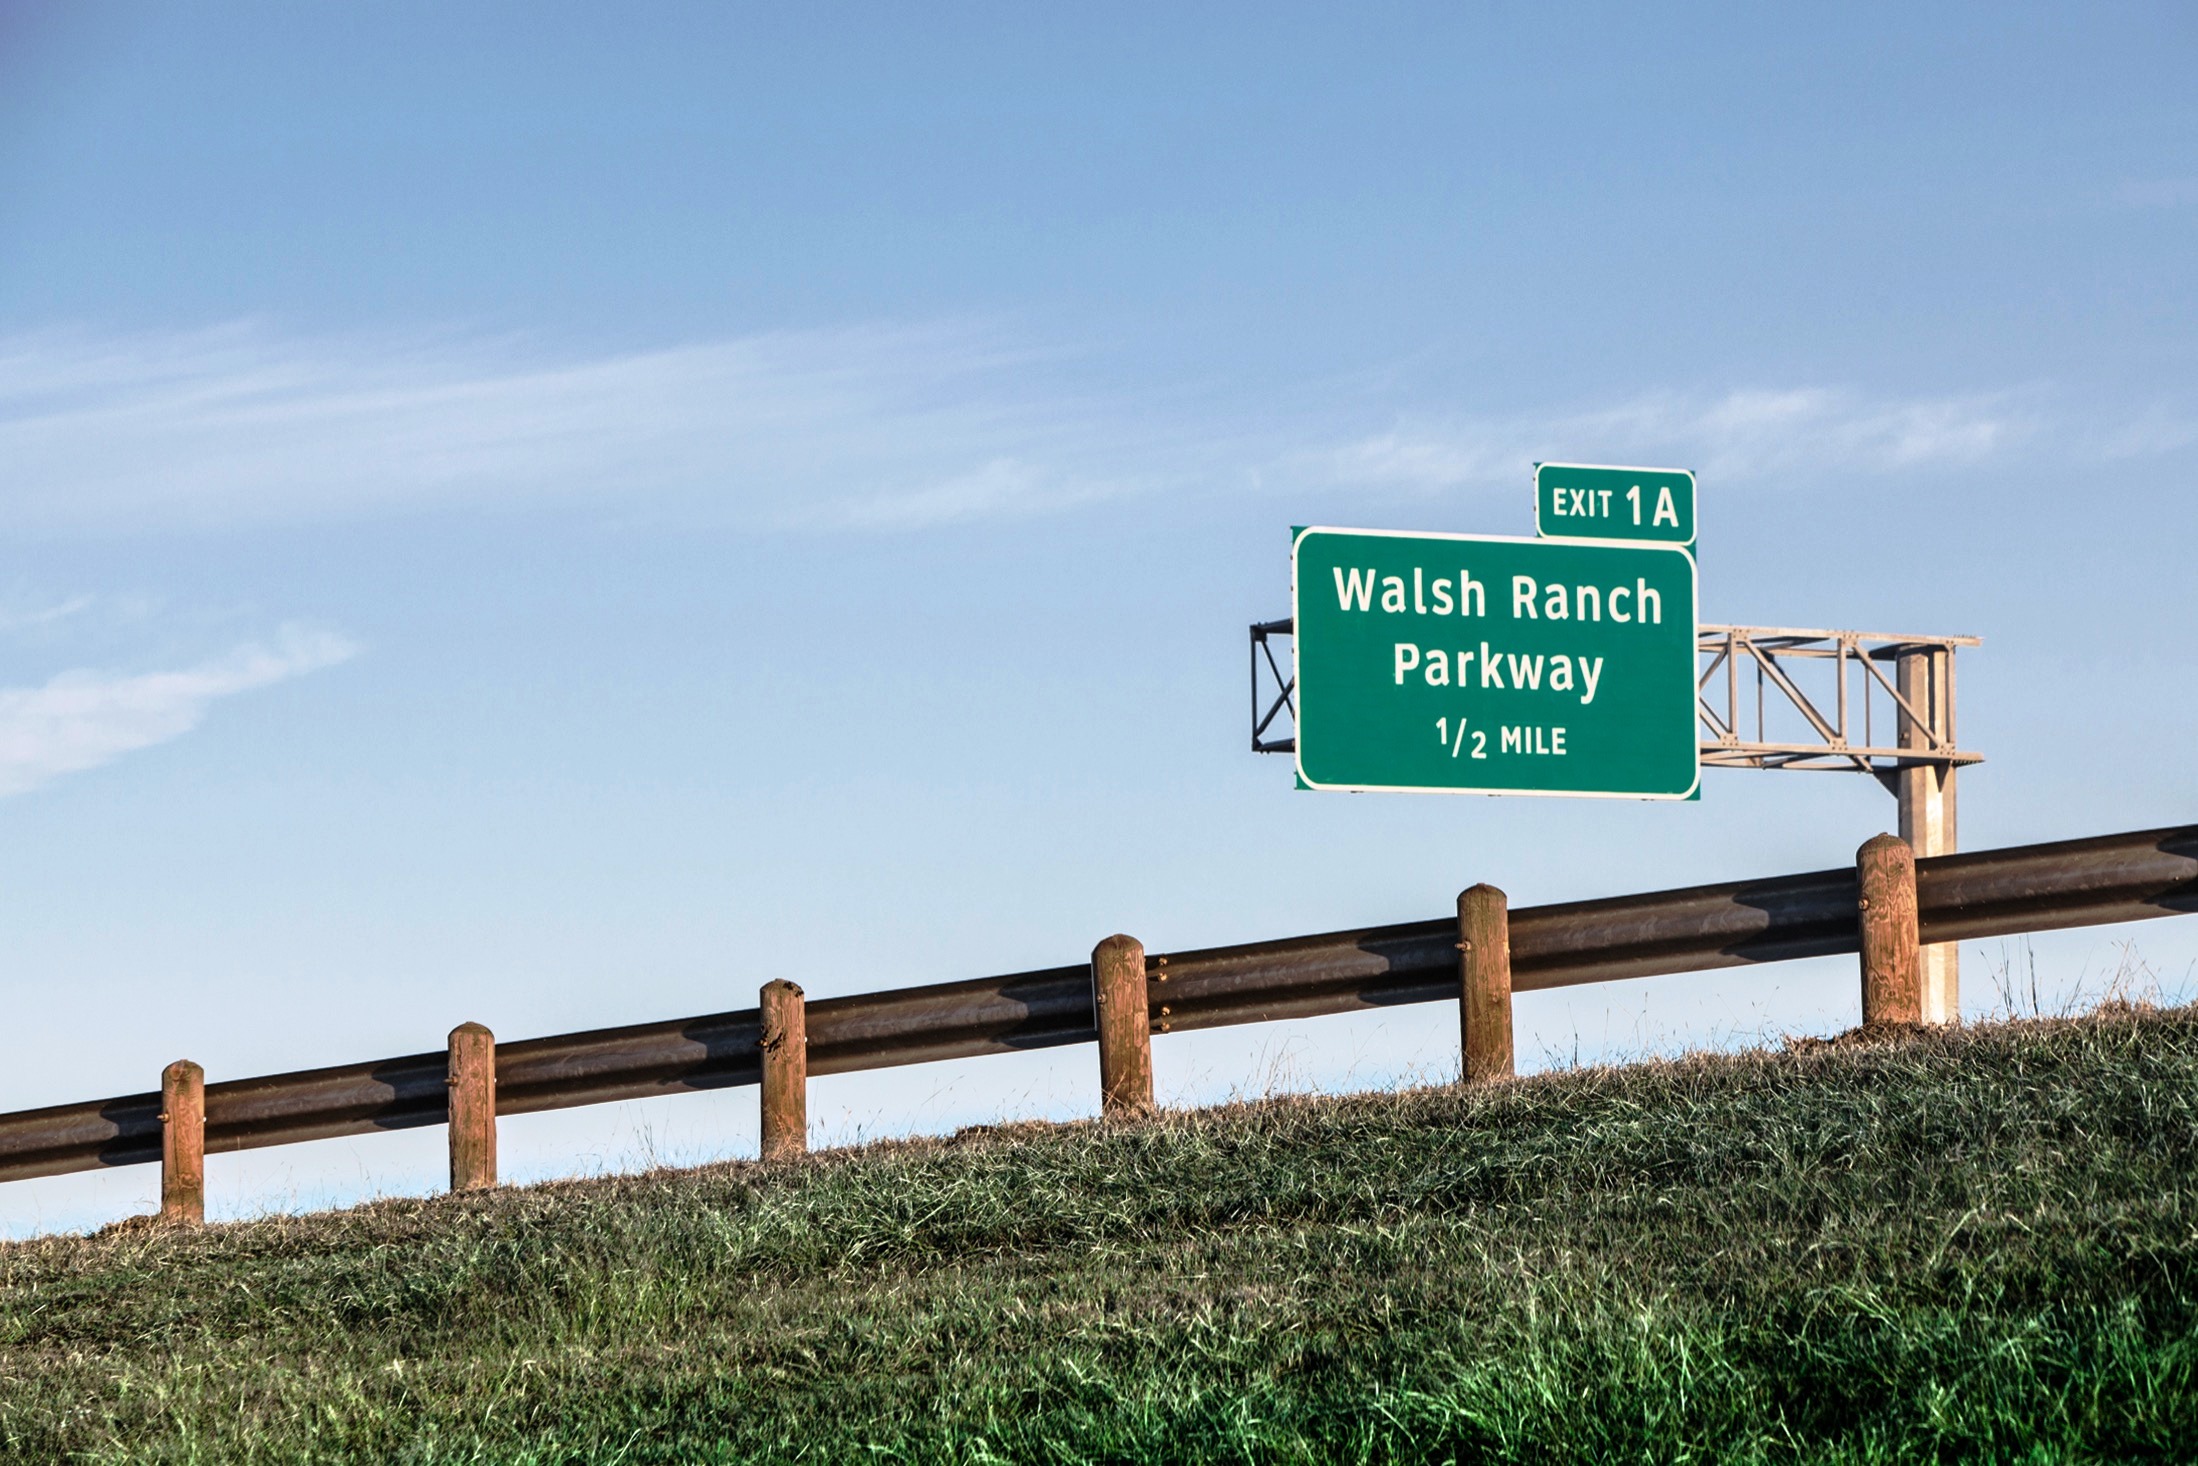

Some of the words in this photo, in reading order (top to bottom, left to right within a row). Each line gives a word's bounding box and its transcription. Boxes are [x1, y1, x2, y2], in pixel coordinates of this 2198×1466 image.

[1553, 487, 1613, 518] EXIT
[1332, 566, 1486, 617] Walsh
[1512, 575, 1661, 624] Ranch
[1394, 643, 1604, 705] Parkway
[1435, 717, 1487, 759] 1/2
[1501, 725, 1567, 755] MILE
